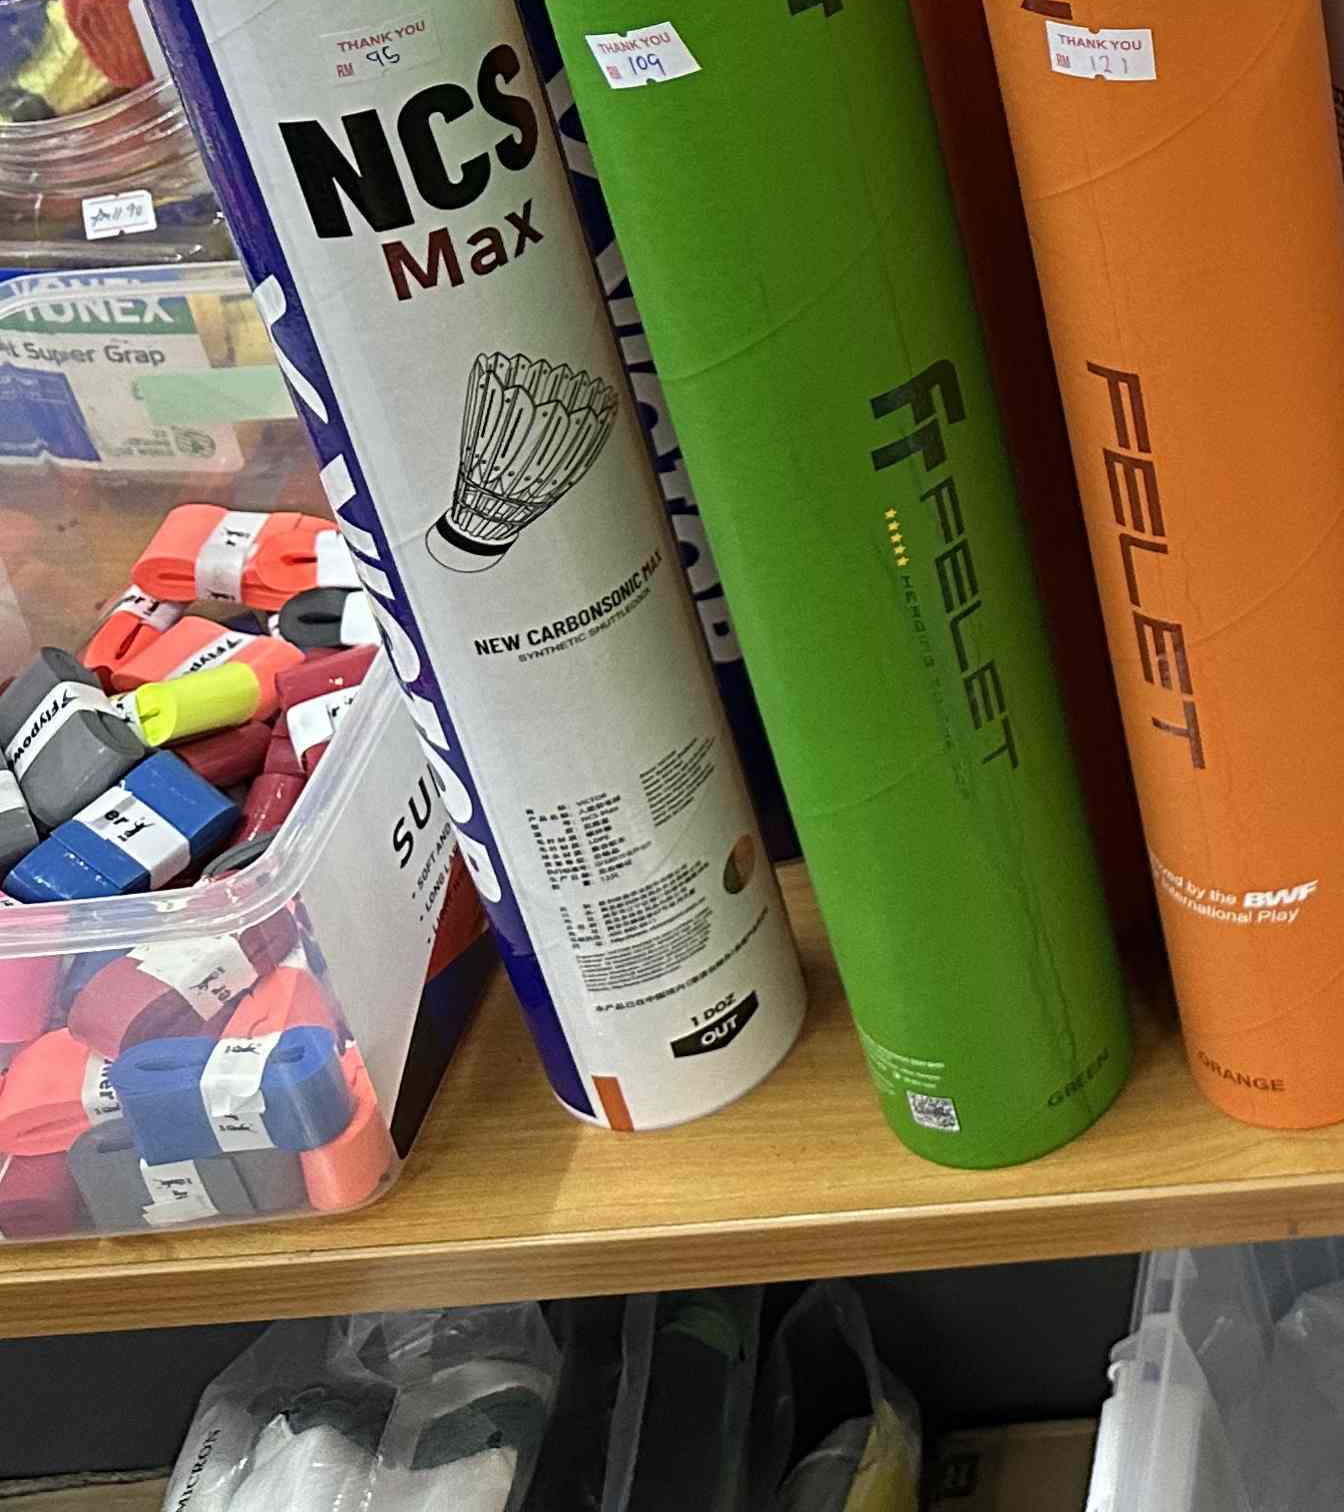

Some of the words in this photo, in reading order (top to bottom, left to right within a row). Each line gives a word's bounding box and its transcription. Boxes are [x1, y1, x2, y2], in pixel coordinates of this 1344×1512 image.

[336, 31, 394, 54] THANK
[391, 19, 427, 42] YOU
[598, 37, 642, 58] THANK
[643, 32, 674, 49] YOU
[1056, 32, 1109, 52] THANK
[1108, 37, 1143, 52] YOU
[627, 51, 666, 78] 109
[277, 42, 539, 240] NCS
[380, 197, 545, 302] Max
[23, 341, 96, 365] Super
[104, 343, 166, 365] Grap
[1086, 359, 1207, 771] FELET
[473, 635, 522, 659] NEW
[526, 574, 644, 648] CARBONSONIC
[637, 549, 664, 586] MAX
[919, 474, 1020, 770] FELET
[516, 632, 588, 664] SYNTHETIC
[416, 853, 438, 891] SOFT
[424, 876, 450, 914] LONG
[1186, 877, 1206, 901] by
[1209, 889, 1239, 906] the
[1242, 878, 1321, 910] BWF
[1257, 906, 1301, 926] Play
[701, 991, 740, 1022] DOZ
[699, 1012, 741, 1048] OUT
[1046, 1048, 1111, 1109] GREEN
[1196, 1049, 1288, 1093] ORANGE
